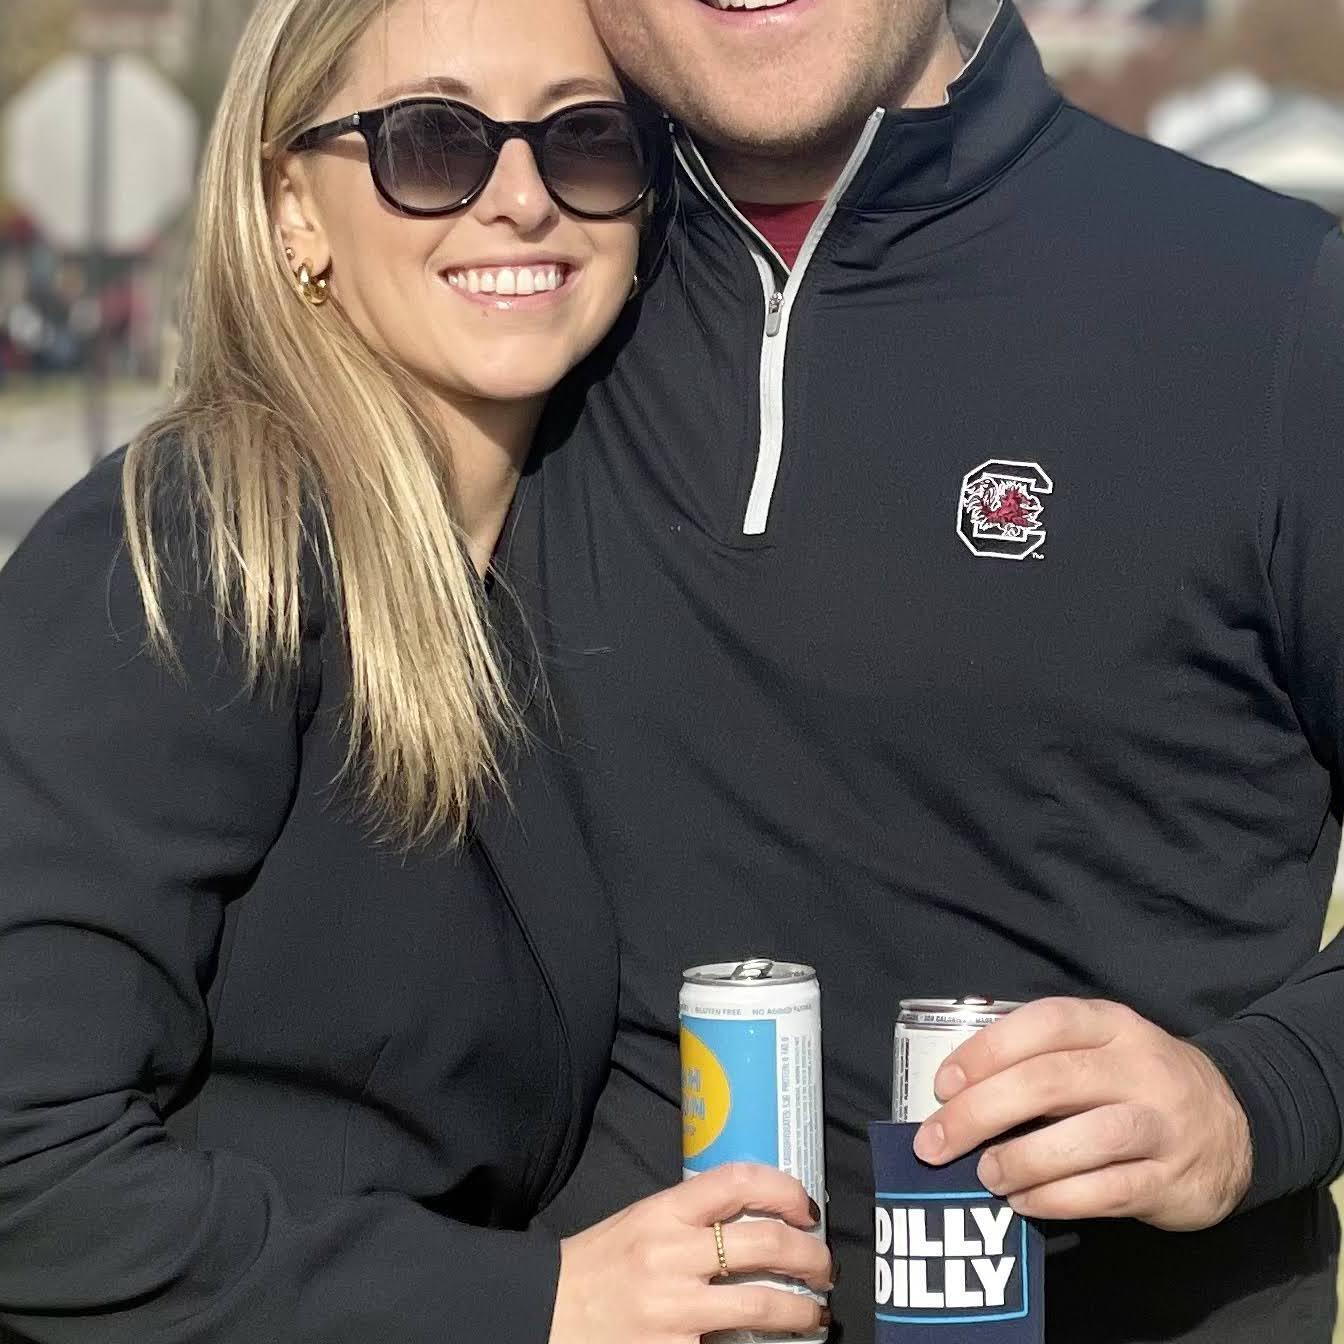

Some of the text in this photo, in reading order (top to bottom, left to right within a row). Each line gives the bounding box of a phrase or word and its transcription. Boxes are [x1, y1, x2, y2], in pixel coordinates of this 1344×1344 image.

[956, 458, 1053, 560] C
[722, 1008, 742, 1016] FREE
[752, 1008, 765, 1016] NO
[875, 1207, 1014, 1257] DILLY
[874, 1257, 1016, 1308] DILLY
